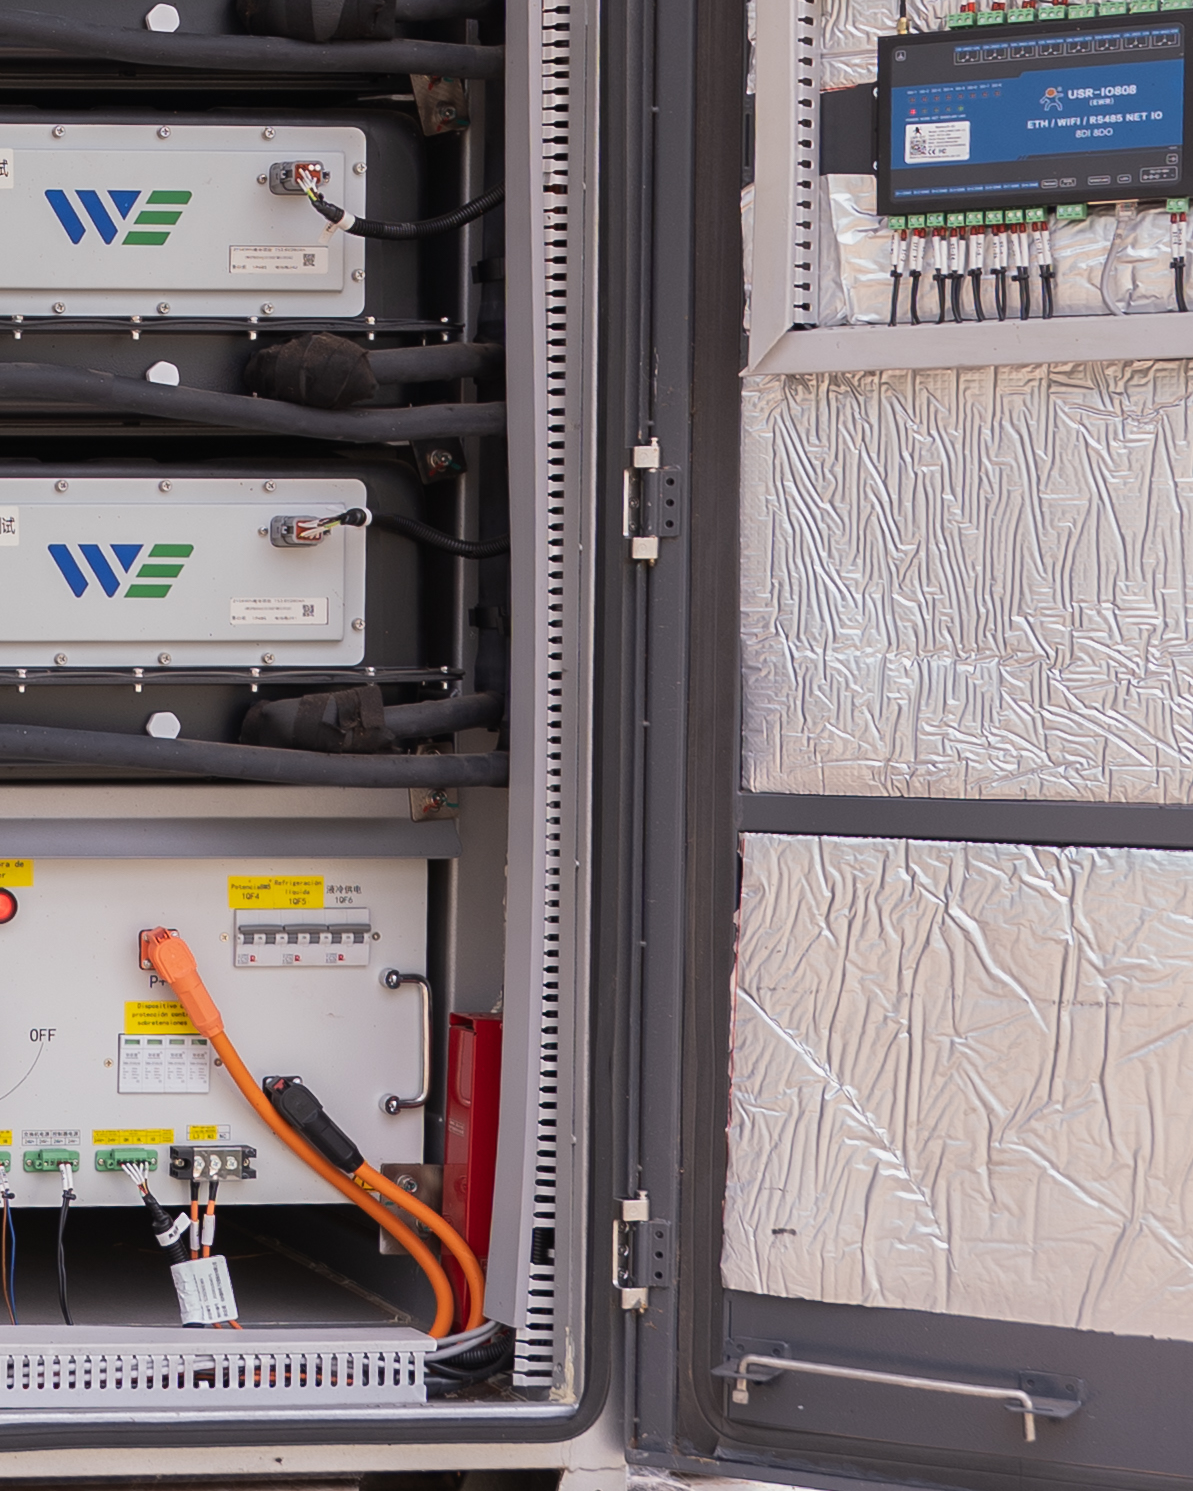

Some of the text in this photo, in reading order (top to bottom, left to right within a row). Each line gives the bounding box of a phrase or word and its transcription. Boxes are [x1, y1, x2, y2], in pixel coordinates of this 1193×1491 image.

[1027, 120, 1049, 129] ETH
[1057, 117, 1080, 127] WIFI
[1089, 114, 1123, 125] RS485
[1125, 112, 1147, 122] NET
[1151, 111, 1163, 120] IO
[29, 1028, 57, 1042] OFF
